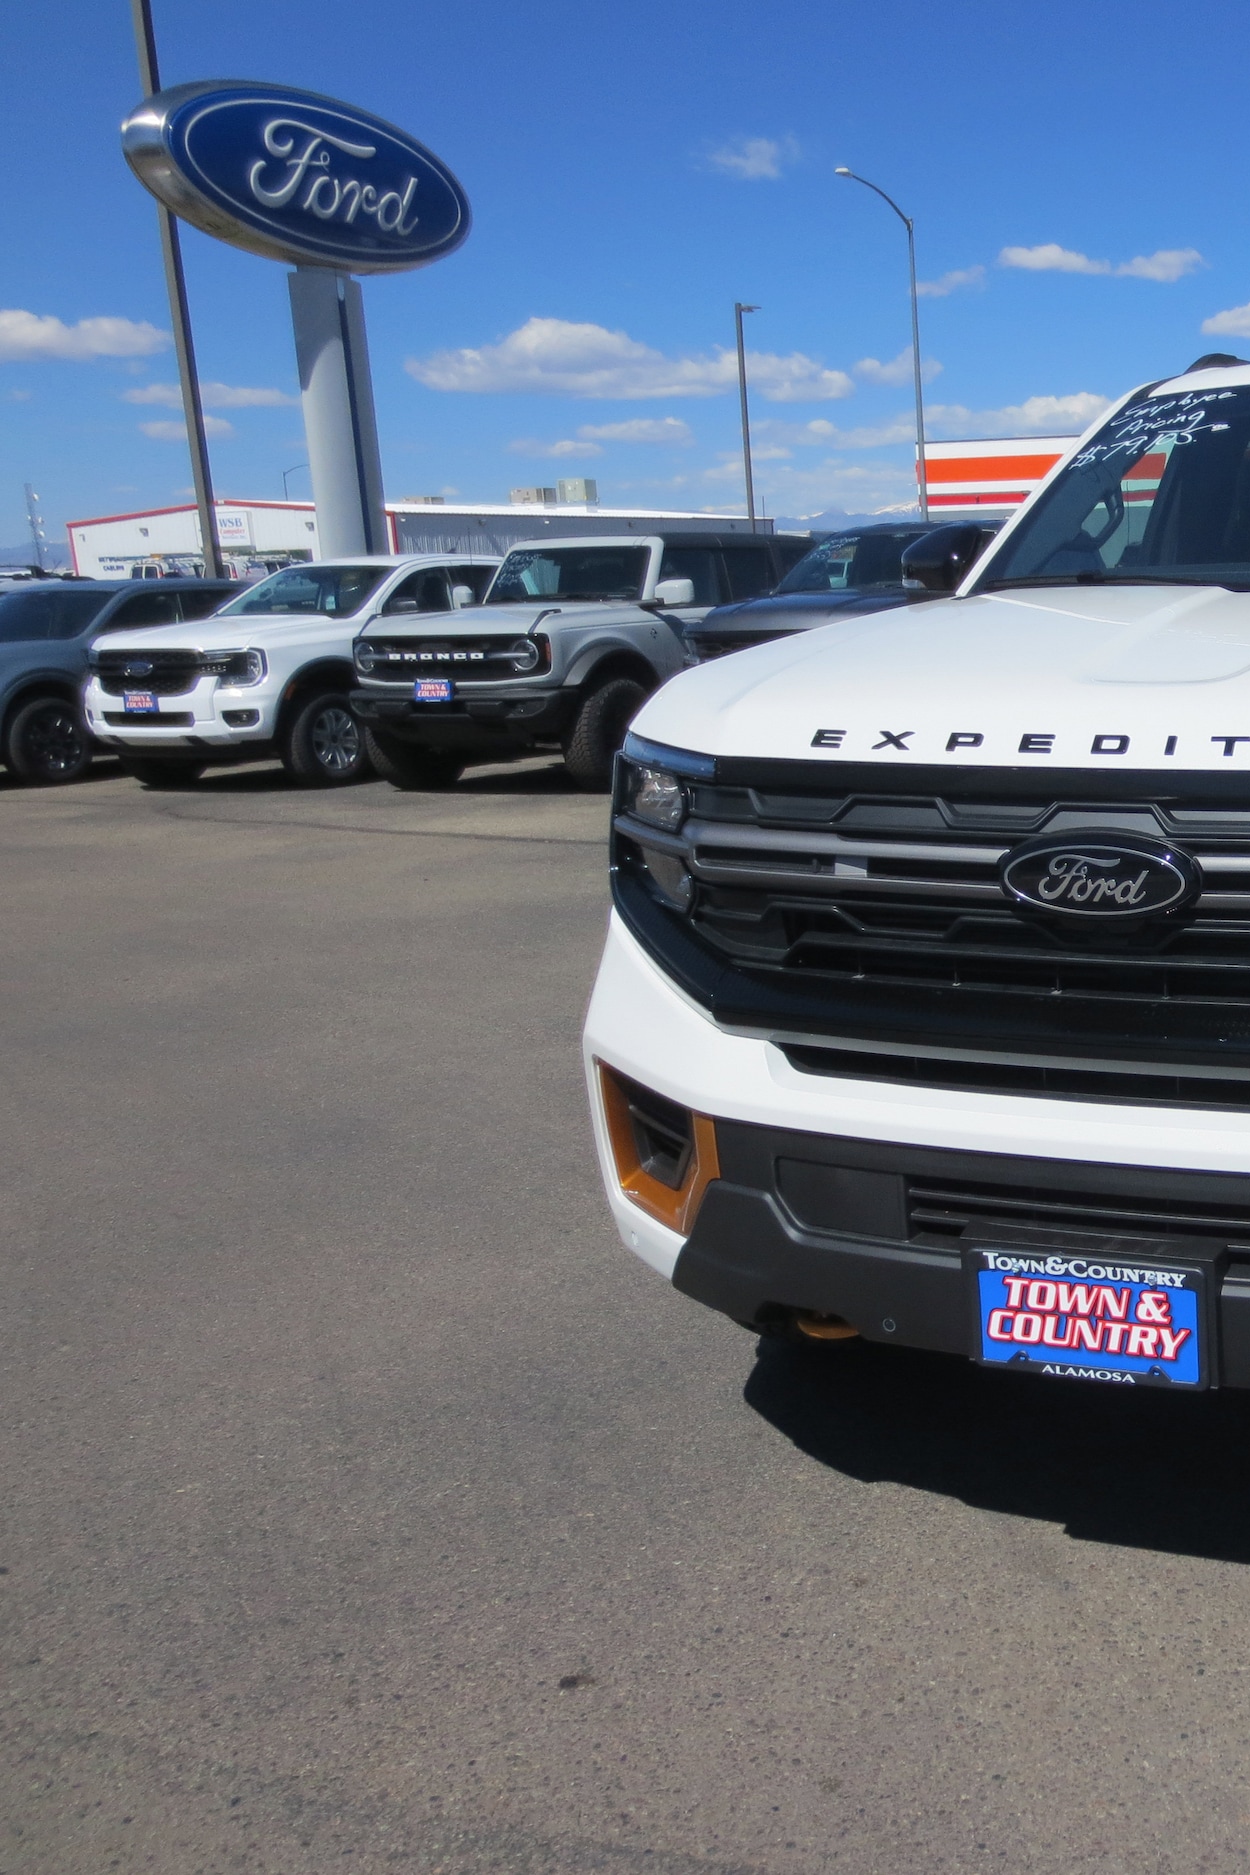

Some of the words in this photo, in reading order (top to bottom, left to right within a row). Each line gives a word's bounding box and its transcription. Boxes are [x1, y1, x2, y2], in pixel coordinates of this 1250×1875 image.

[250, 119, 418, 236] Ford
[218, 517, 243, 528] WSB
[388, 652, 484, 661] BRONCO
[417, 690, 450, 698] COUNTRY
[1038, 853, 1147, 906] Ford
[1003, 1276, 1131, 1319] TOWN
[1135, 1289, 1172, 1326] &
[987, 1308, 1191, 1360] COUNTRY
[1041, 1364, 1136, 1384] ALAMOSA
